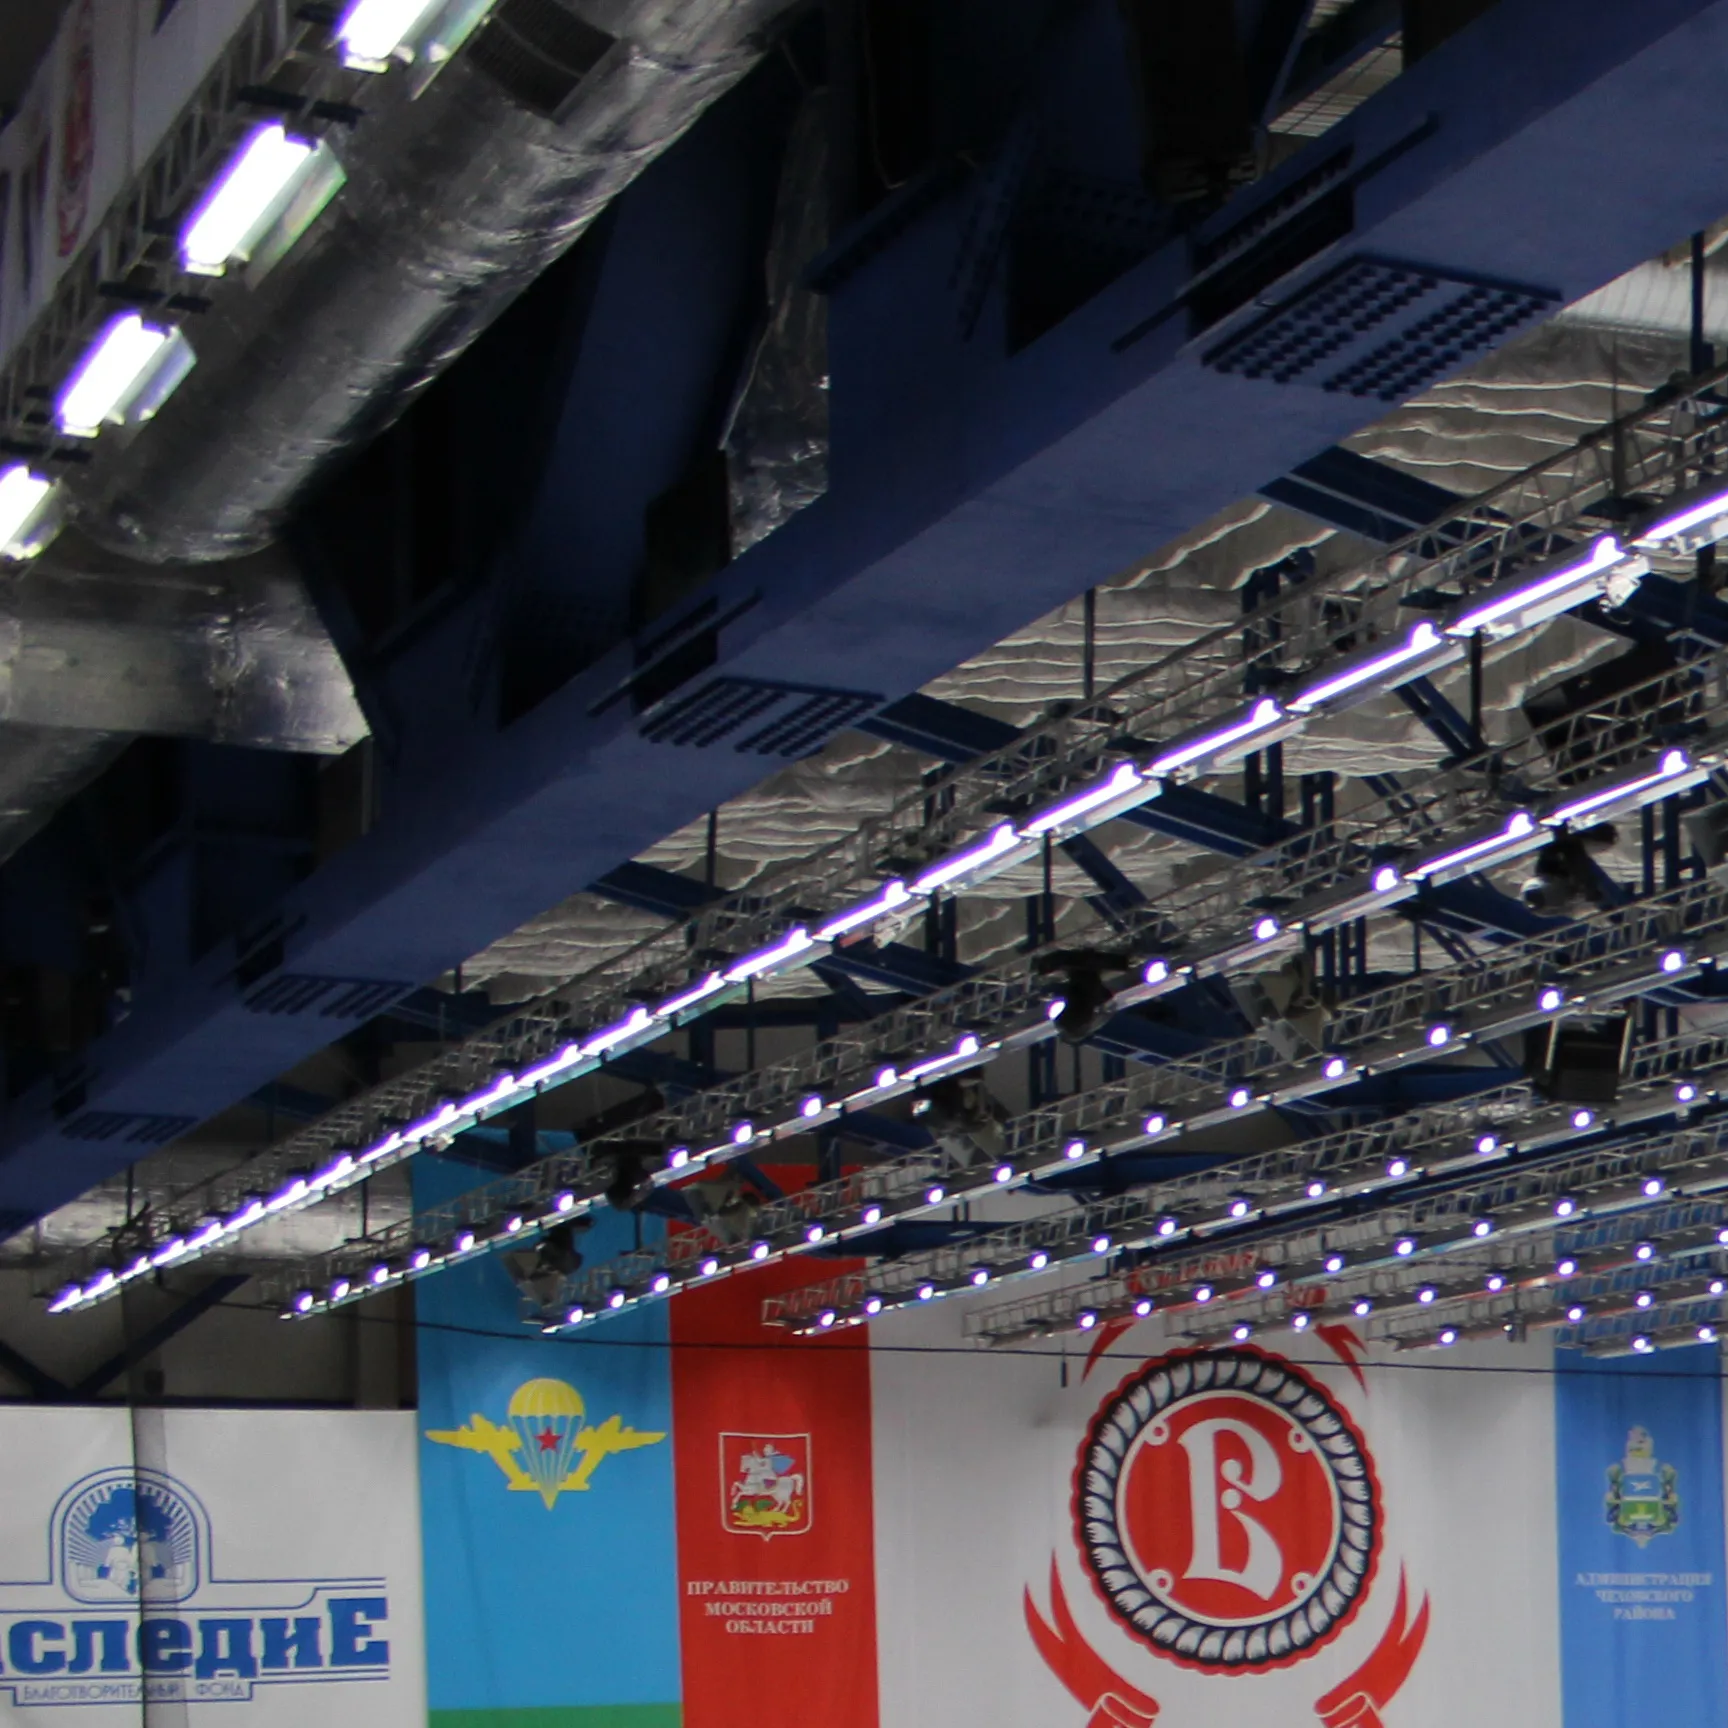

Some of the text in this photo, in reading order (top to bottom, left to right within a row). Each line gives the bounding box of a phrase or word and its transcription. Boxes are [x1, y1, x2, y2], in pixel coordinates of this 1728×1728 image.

[687, 1579, 850, 1596] ПРАВИТЕЛЬСТВО
[704, 1598, 834, 1617] МОСКОВСКОЙ
[725, 1619, 815, 1635] ОБЛАСТИ
